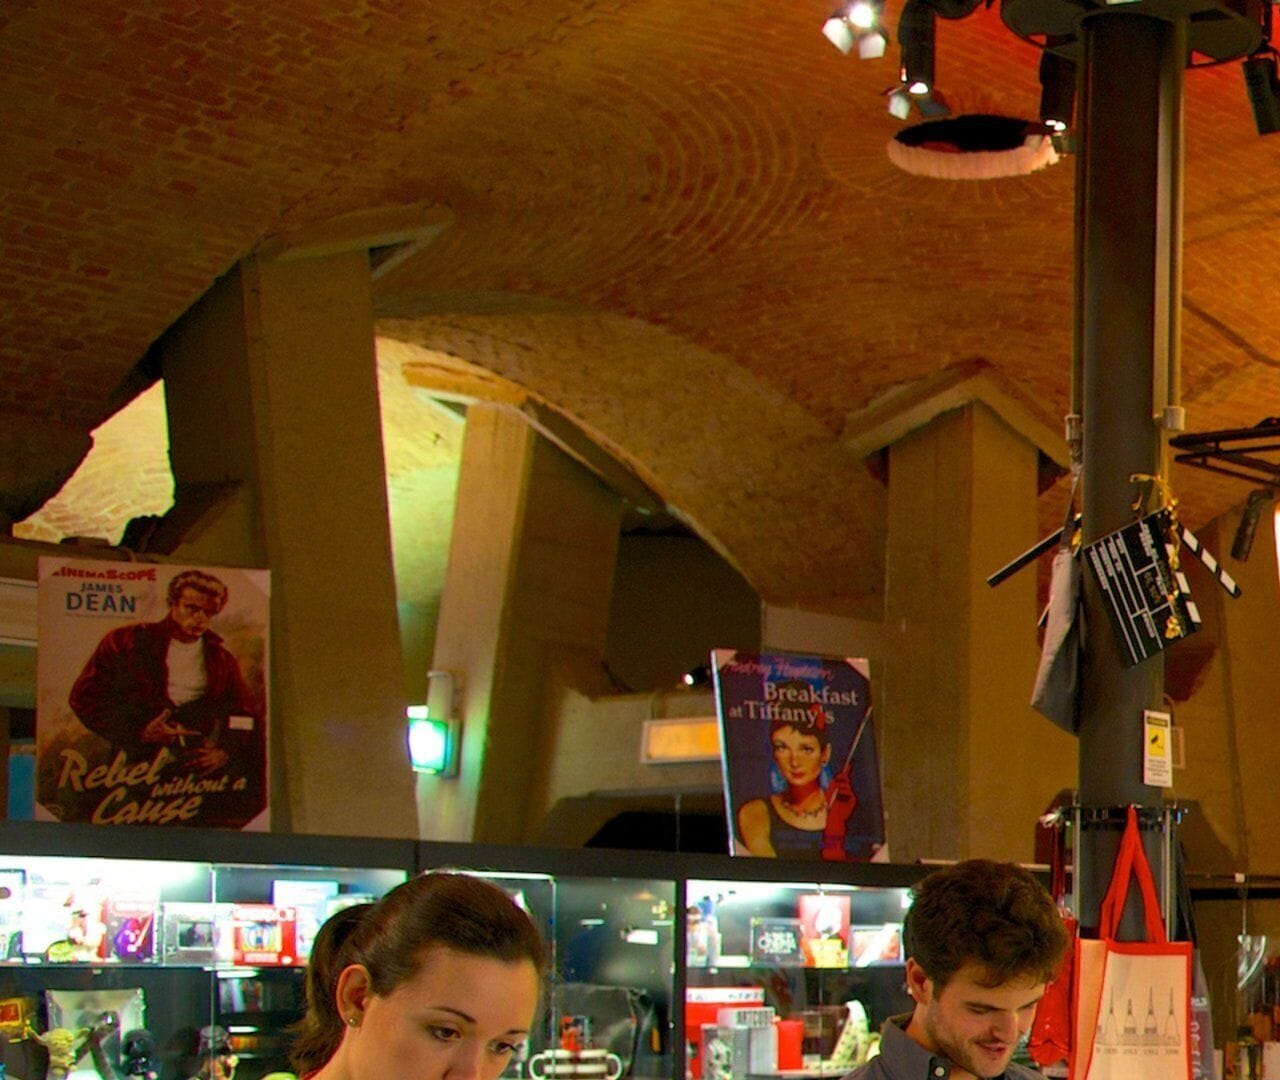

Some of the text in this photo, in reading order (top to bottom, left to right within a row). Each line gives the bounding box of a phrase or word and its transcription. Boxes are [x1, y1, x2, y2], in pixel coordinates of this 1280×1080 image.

[79, 582, 123, 594] JAMES
[65, 592, 136, 613] DEAN
[763, 681, 858, 706] Breakfast
[728, 700, 835, 728] at Tiffany's
[57, 746, 172, 793] Rebel
[151, 773, 247, 798] without a
[91, 786, 203, 826] Cause
